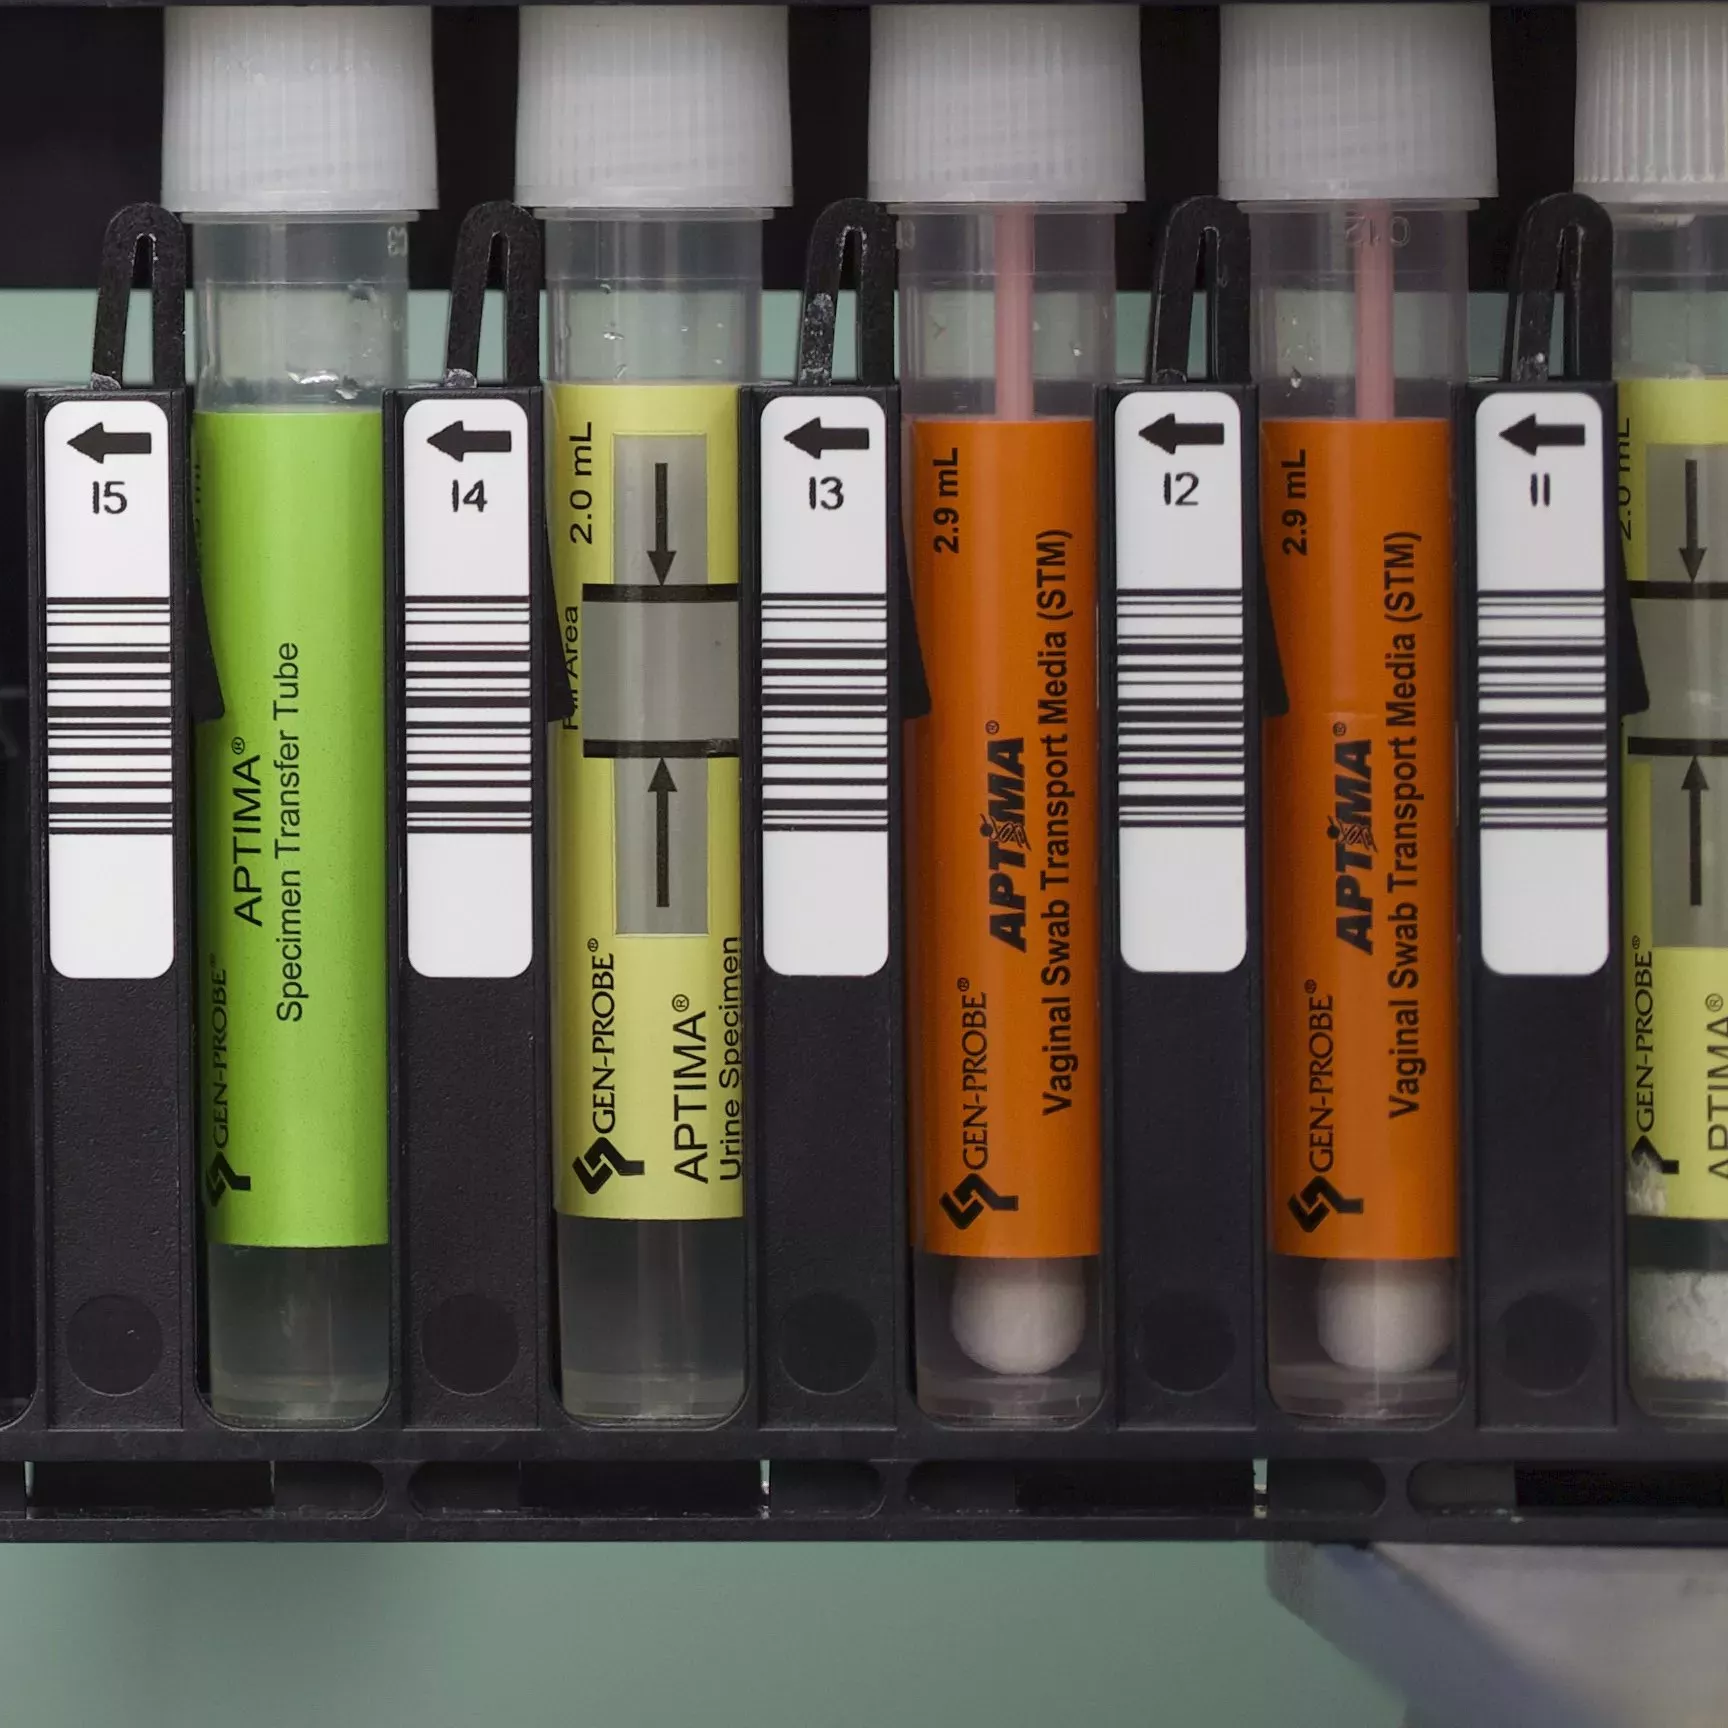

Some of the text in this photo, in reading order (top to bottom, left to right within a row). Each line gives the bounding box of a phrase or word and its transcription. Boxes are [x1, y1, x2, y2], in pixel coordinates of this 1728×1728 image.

[569, 421, 592, 545] 2.0 mL
[932, 447, 959, 554] 2.9 mL
[1281, 449, 1307, 556] 2.9 mL
[565, 605, 578, 684] Area
[272, 642, 310, 1022] Specimen Transfer Tube
[1035, 529, 1079, 1116] Vaginal Swab Transport Media (STM)
[1383, 531, 1427, 1119] Vaginal Swab Transport Media (STM)
[718, 936, 742, 1181] Urine Specimen
